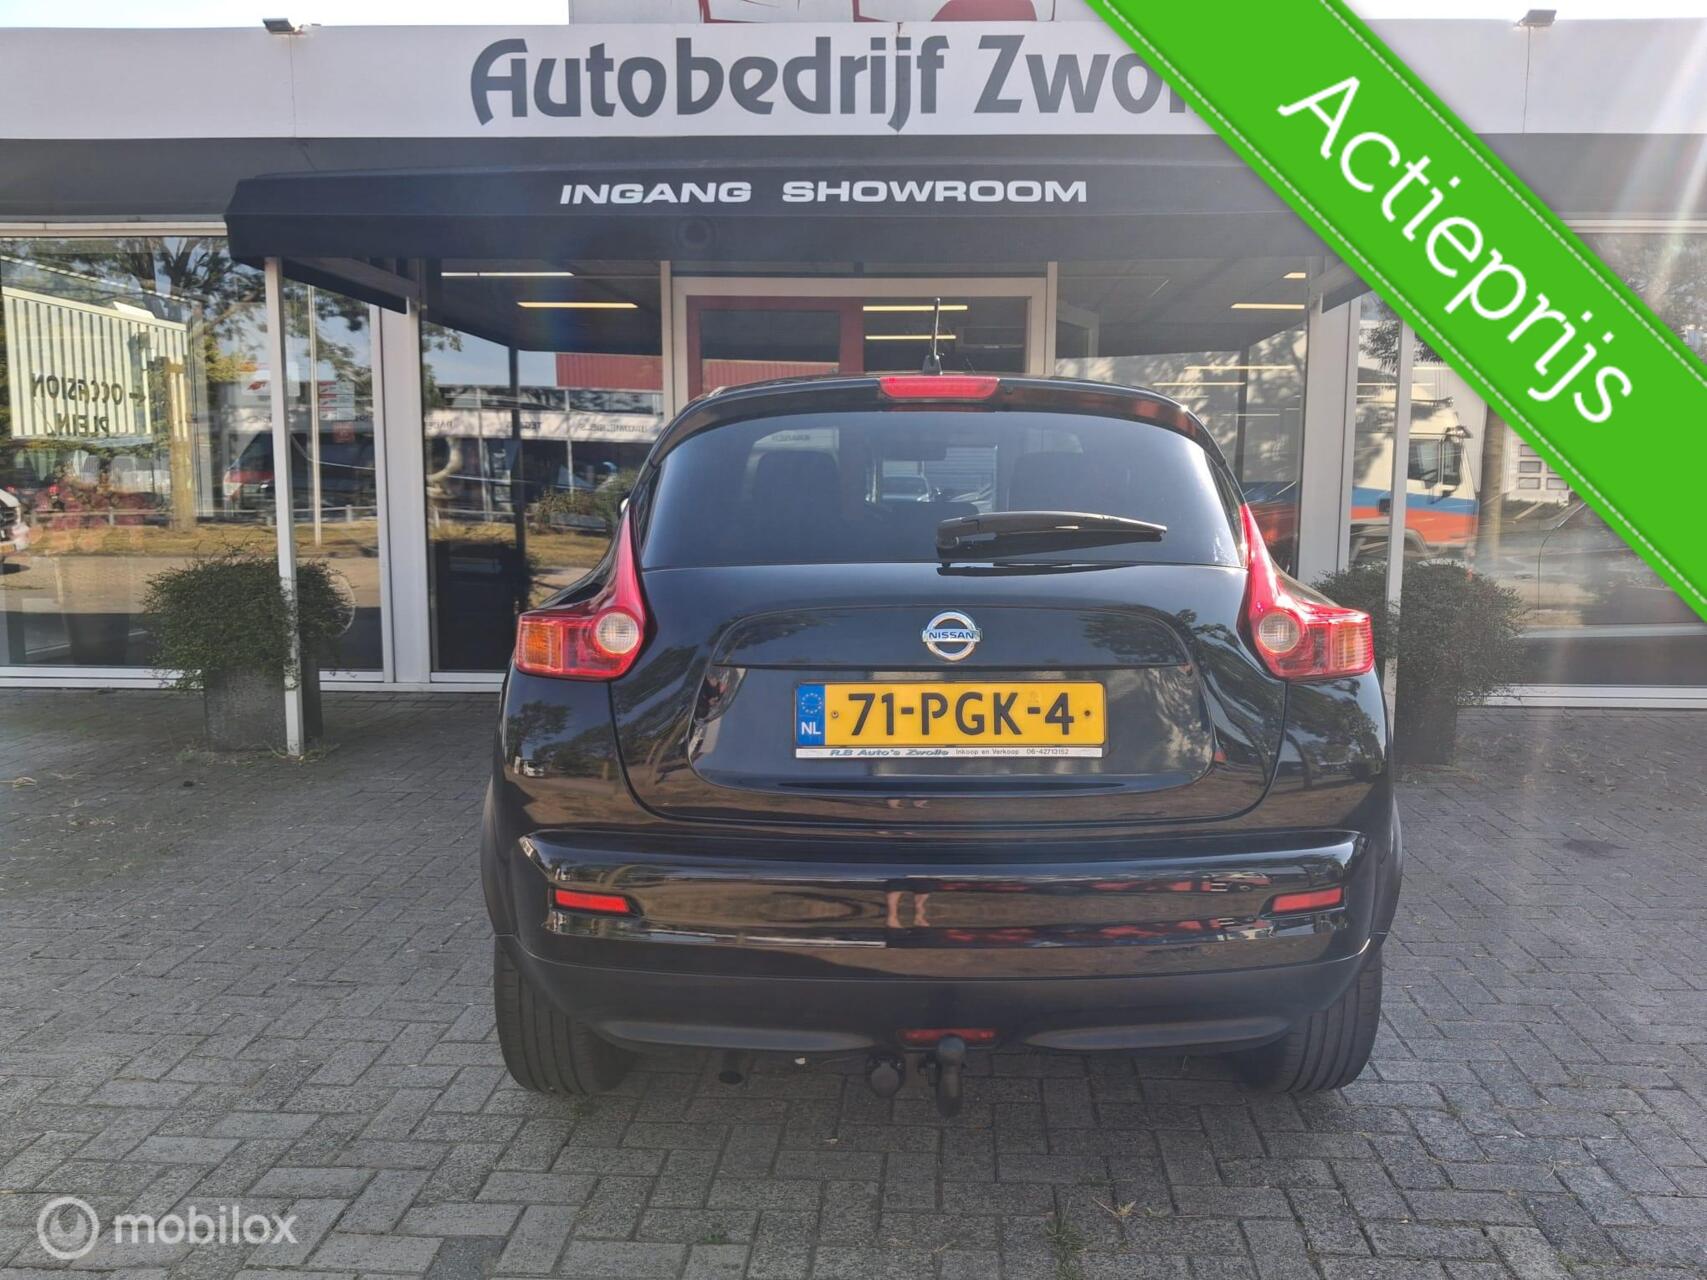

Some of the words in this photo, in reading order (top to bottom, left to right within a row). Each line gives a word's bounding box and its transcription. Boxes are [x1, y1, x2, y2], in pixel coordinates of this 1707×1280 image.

[470, 35, 949, 133] Autobedrijf
[973, 34, 1186, 117] Zwo
[560, 182, 752, 205] INGANG
[782, 180, 1088, 204] SHOWROOM
[928, 631, 975, 639] NISSAN
[847, 692, 1075, 736] 71-PGK-4
[800, 721, 821, 736] NL
[857, 749, 901, 757] Auto's
[906, 749, 949, 757] Zwolle
[992, 748, 1019, 756] Verkoop
